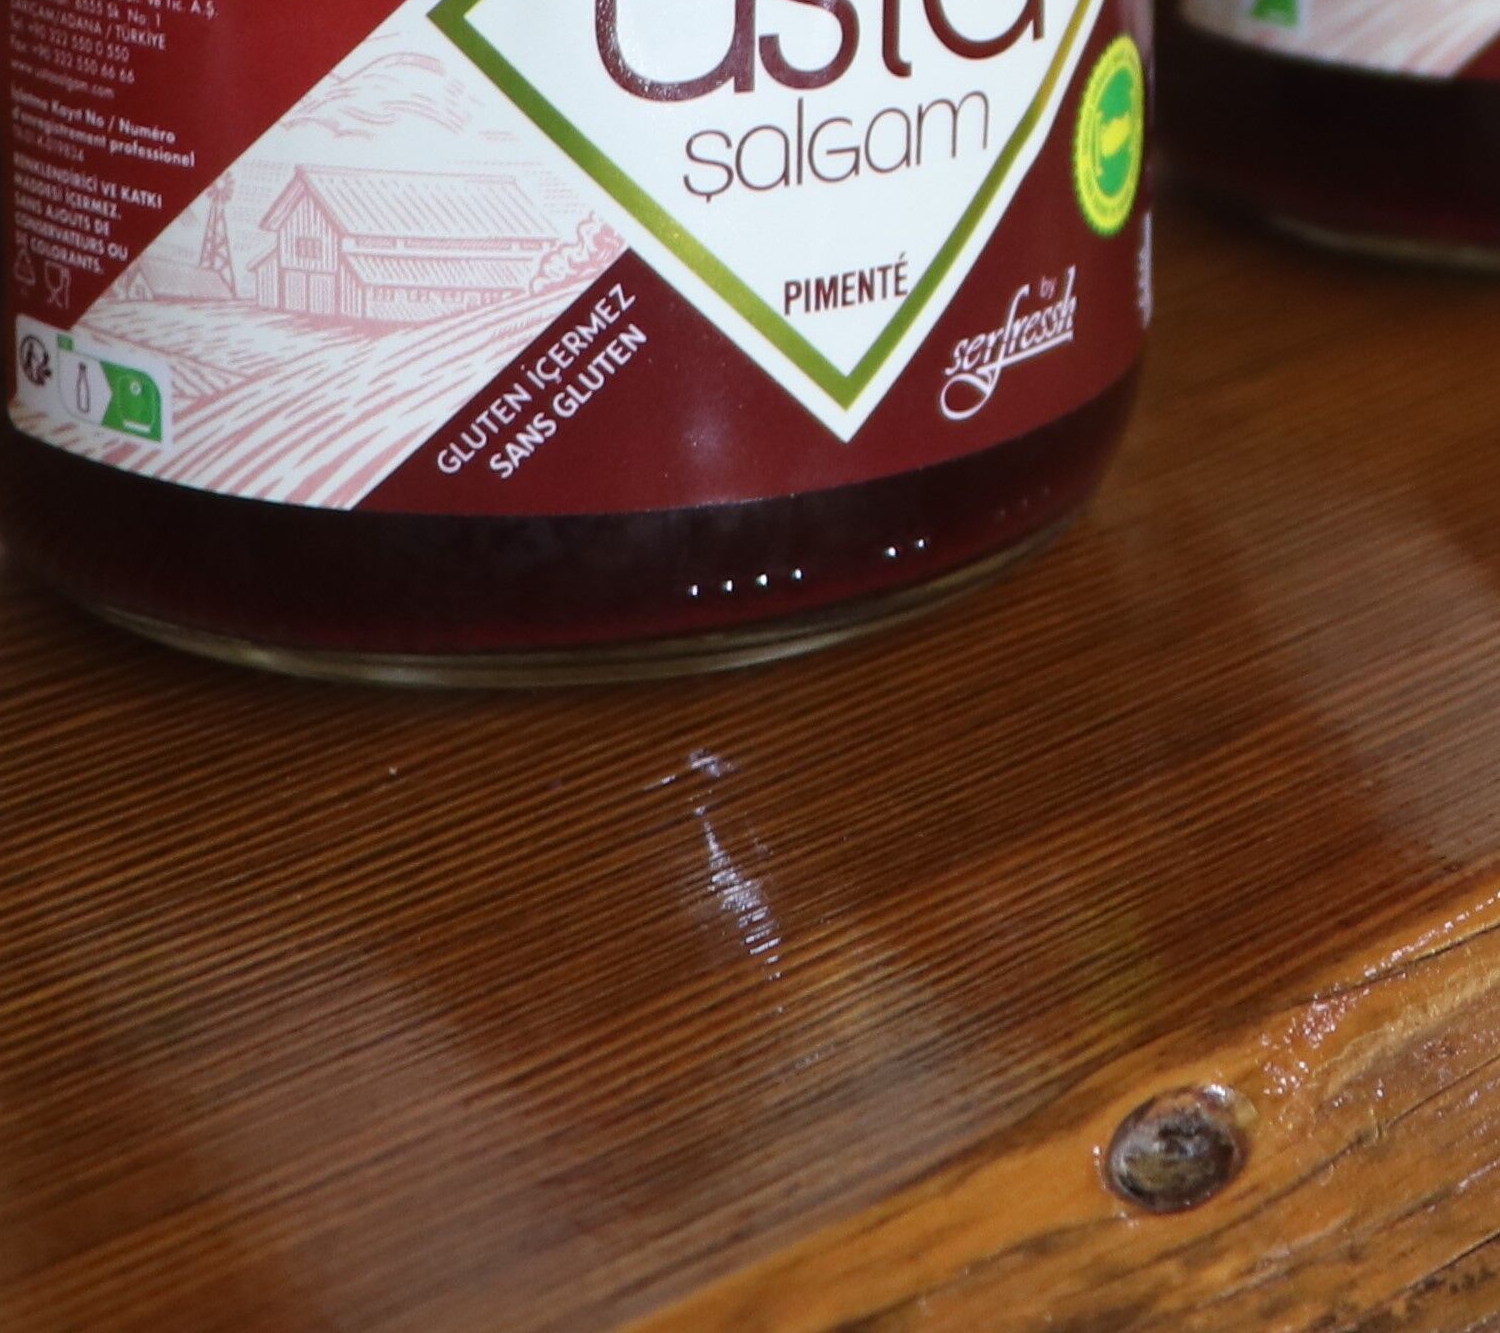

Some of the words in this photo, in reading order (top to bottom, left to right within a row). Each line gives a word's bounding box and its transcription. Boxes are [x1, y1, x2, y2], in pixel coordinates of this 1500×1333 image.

[118, 117, 176, 145] Numéro
[110, 139, 196, 168] professionel
[120, 183, 163, 209] KATKI
[106, 241, 129, 262] OU
[783, 254, 910, 316] PIMENTÉ
[436, 381, 533, 475] GLUTEN
[520, 282, 637, 390] İÇERMEZ
[489, 411, 558, 480] SANS
[552, 322, 649, 419] GLUTEN
